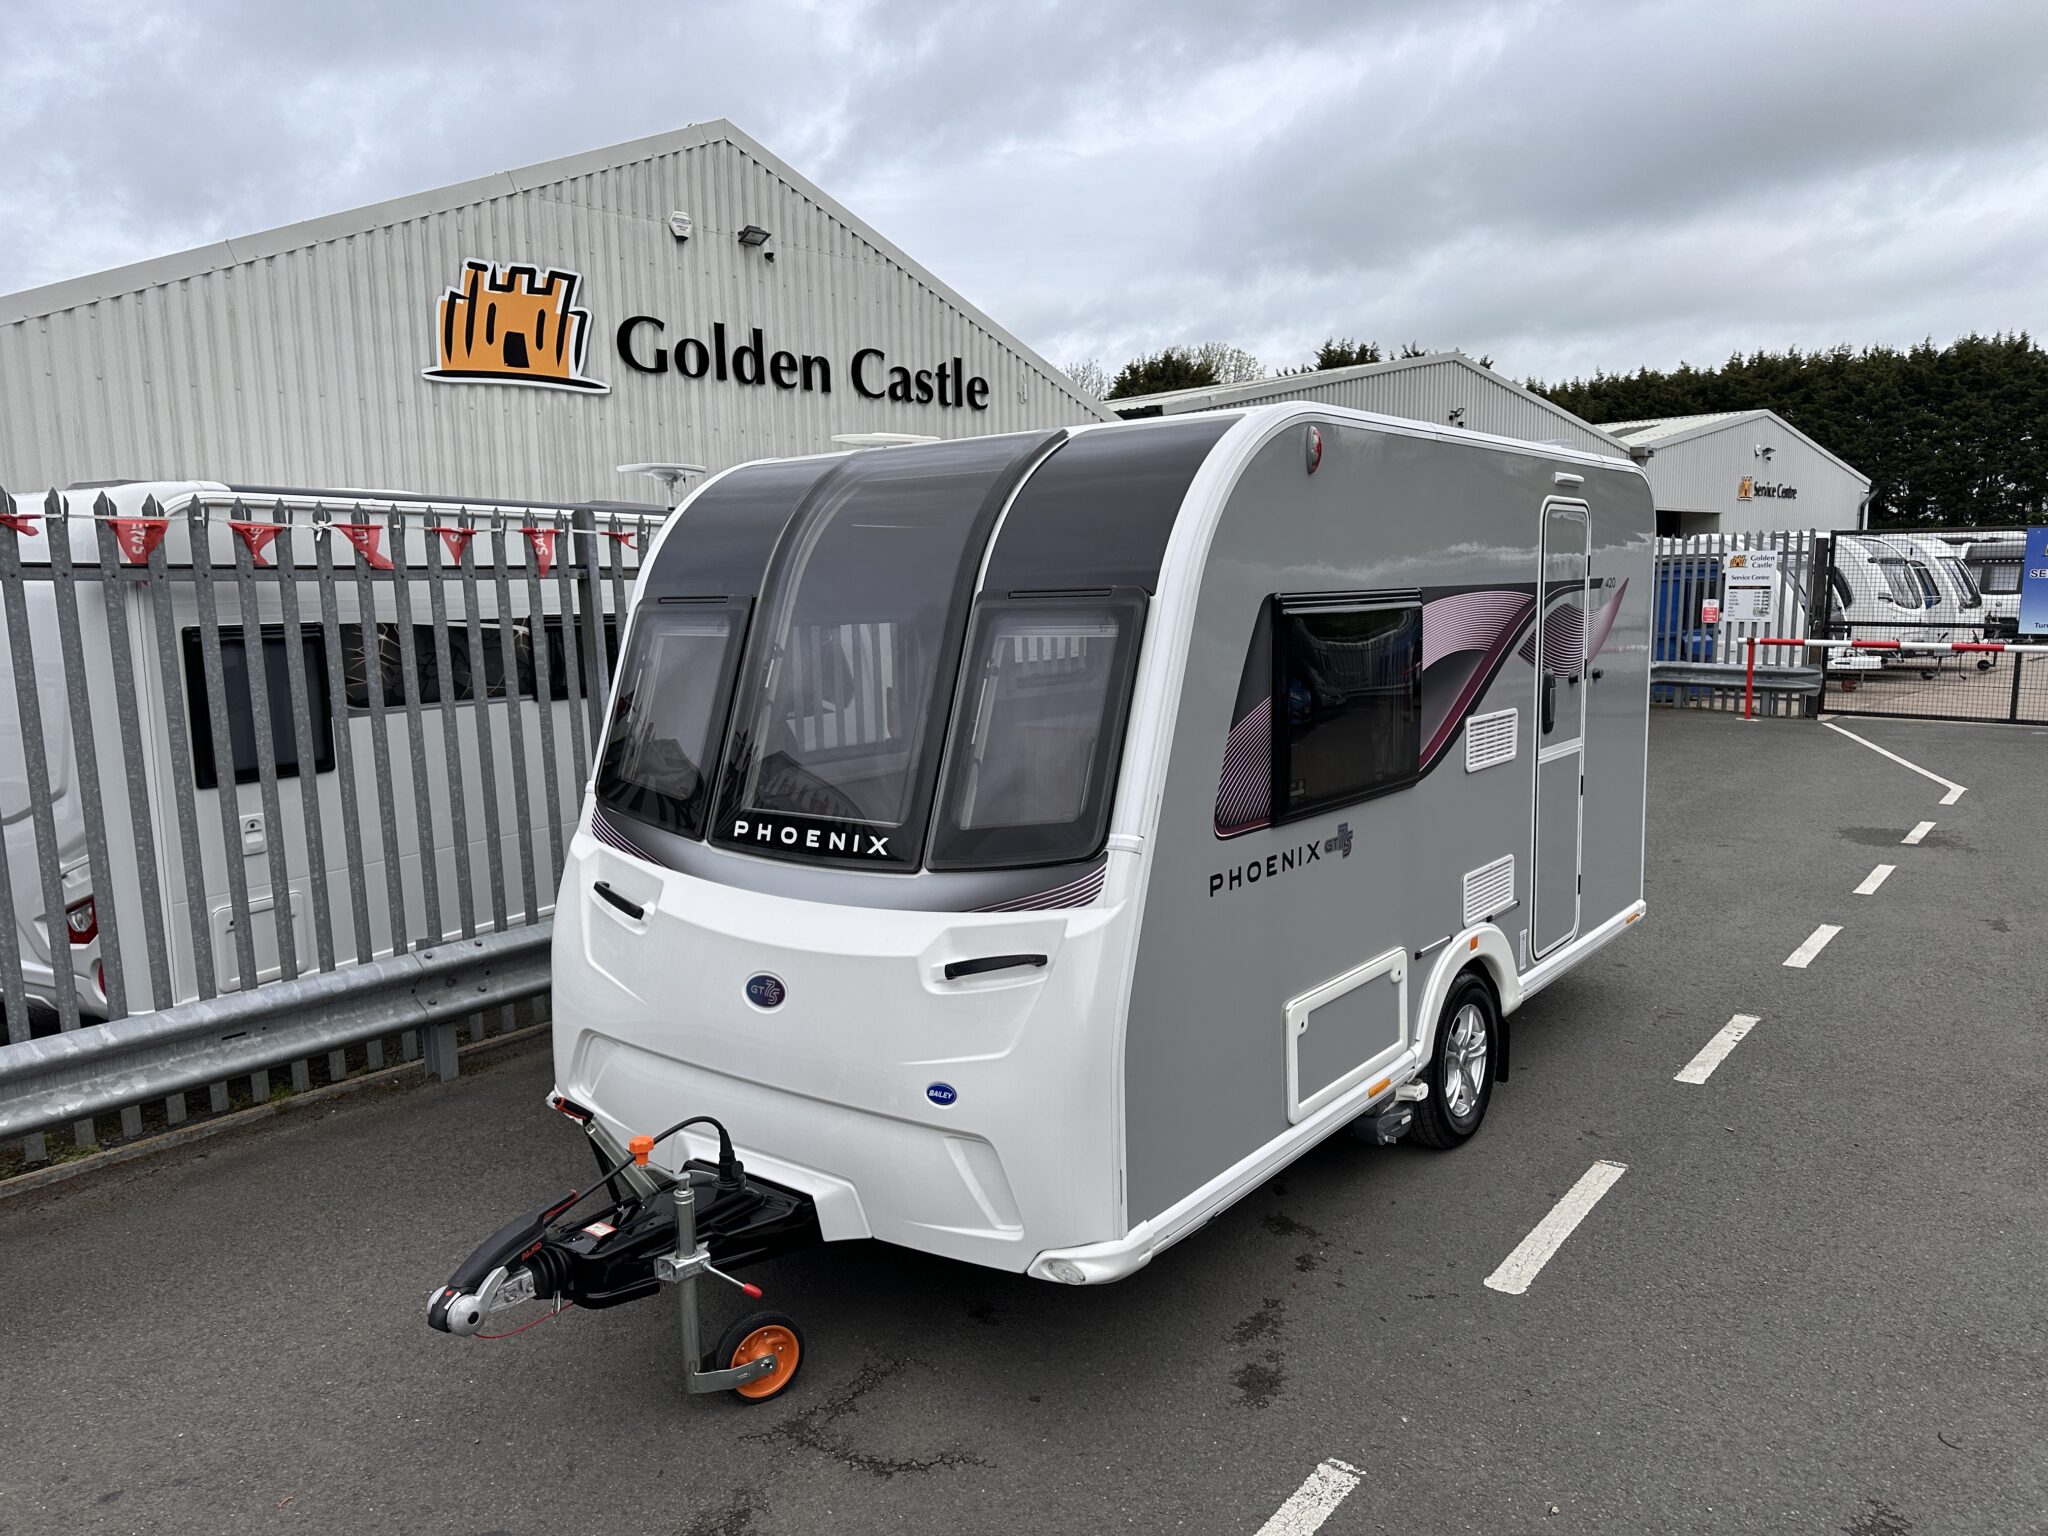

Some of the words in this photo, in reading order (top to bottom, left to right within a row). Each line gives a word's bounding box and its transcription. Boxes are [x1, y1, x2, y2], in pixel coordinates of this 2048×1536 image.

[616, 315, 832, 394] Golden
[851, 348, 990, 410] Castle
[1754, 481, 1777, 498] Service
[1777, 483, 1798, 499] Centre
[1750, 554, 1775, 562] Golden
[733, 820, 890, 856] PHOENIX
[1209, 840, 1321, 898] PHOENIX
[928, 1089, 953, 1100] BAILEY
